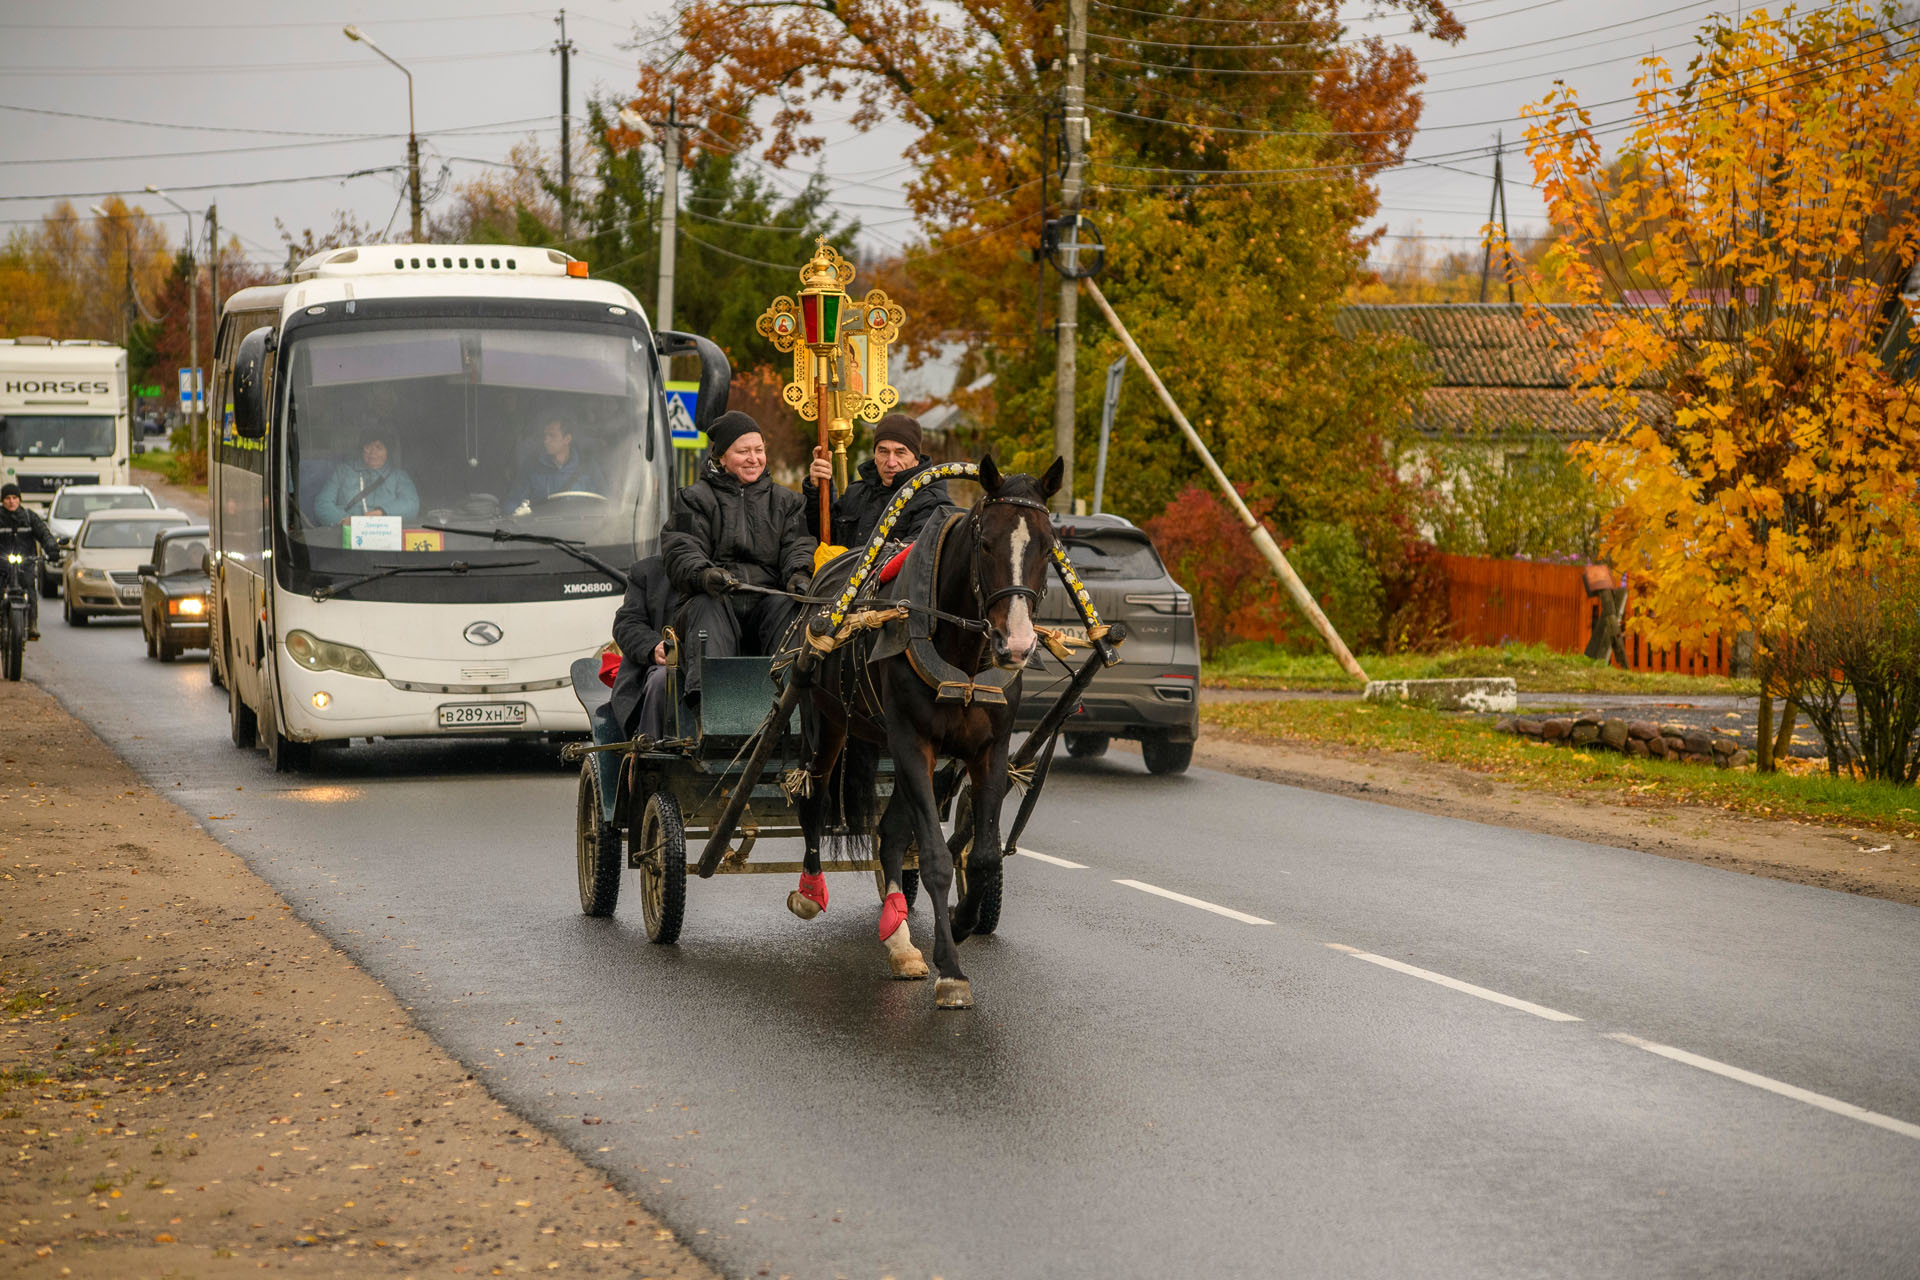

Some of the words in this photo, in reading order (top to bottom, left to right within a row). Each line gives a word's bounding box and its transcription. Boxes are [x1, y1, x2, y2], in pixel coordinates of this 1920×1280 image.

[6, 381, 109, 394] HORSES
[43, 478, 74, 487] MAN
[563, 582, 613, 594] XMQ6800
[507, 706, 520, 716] 76
